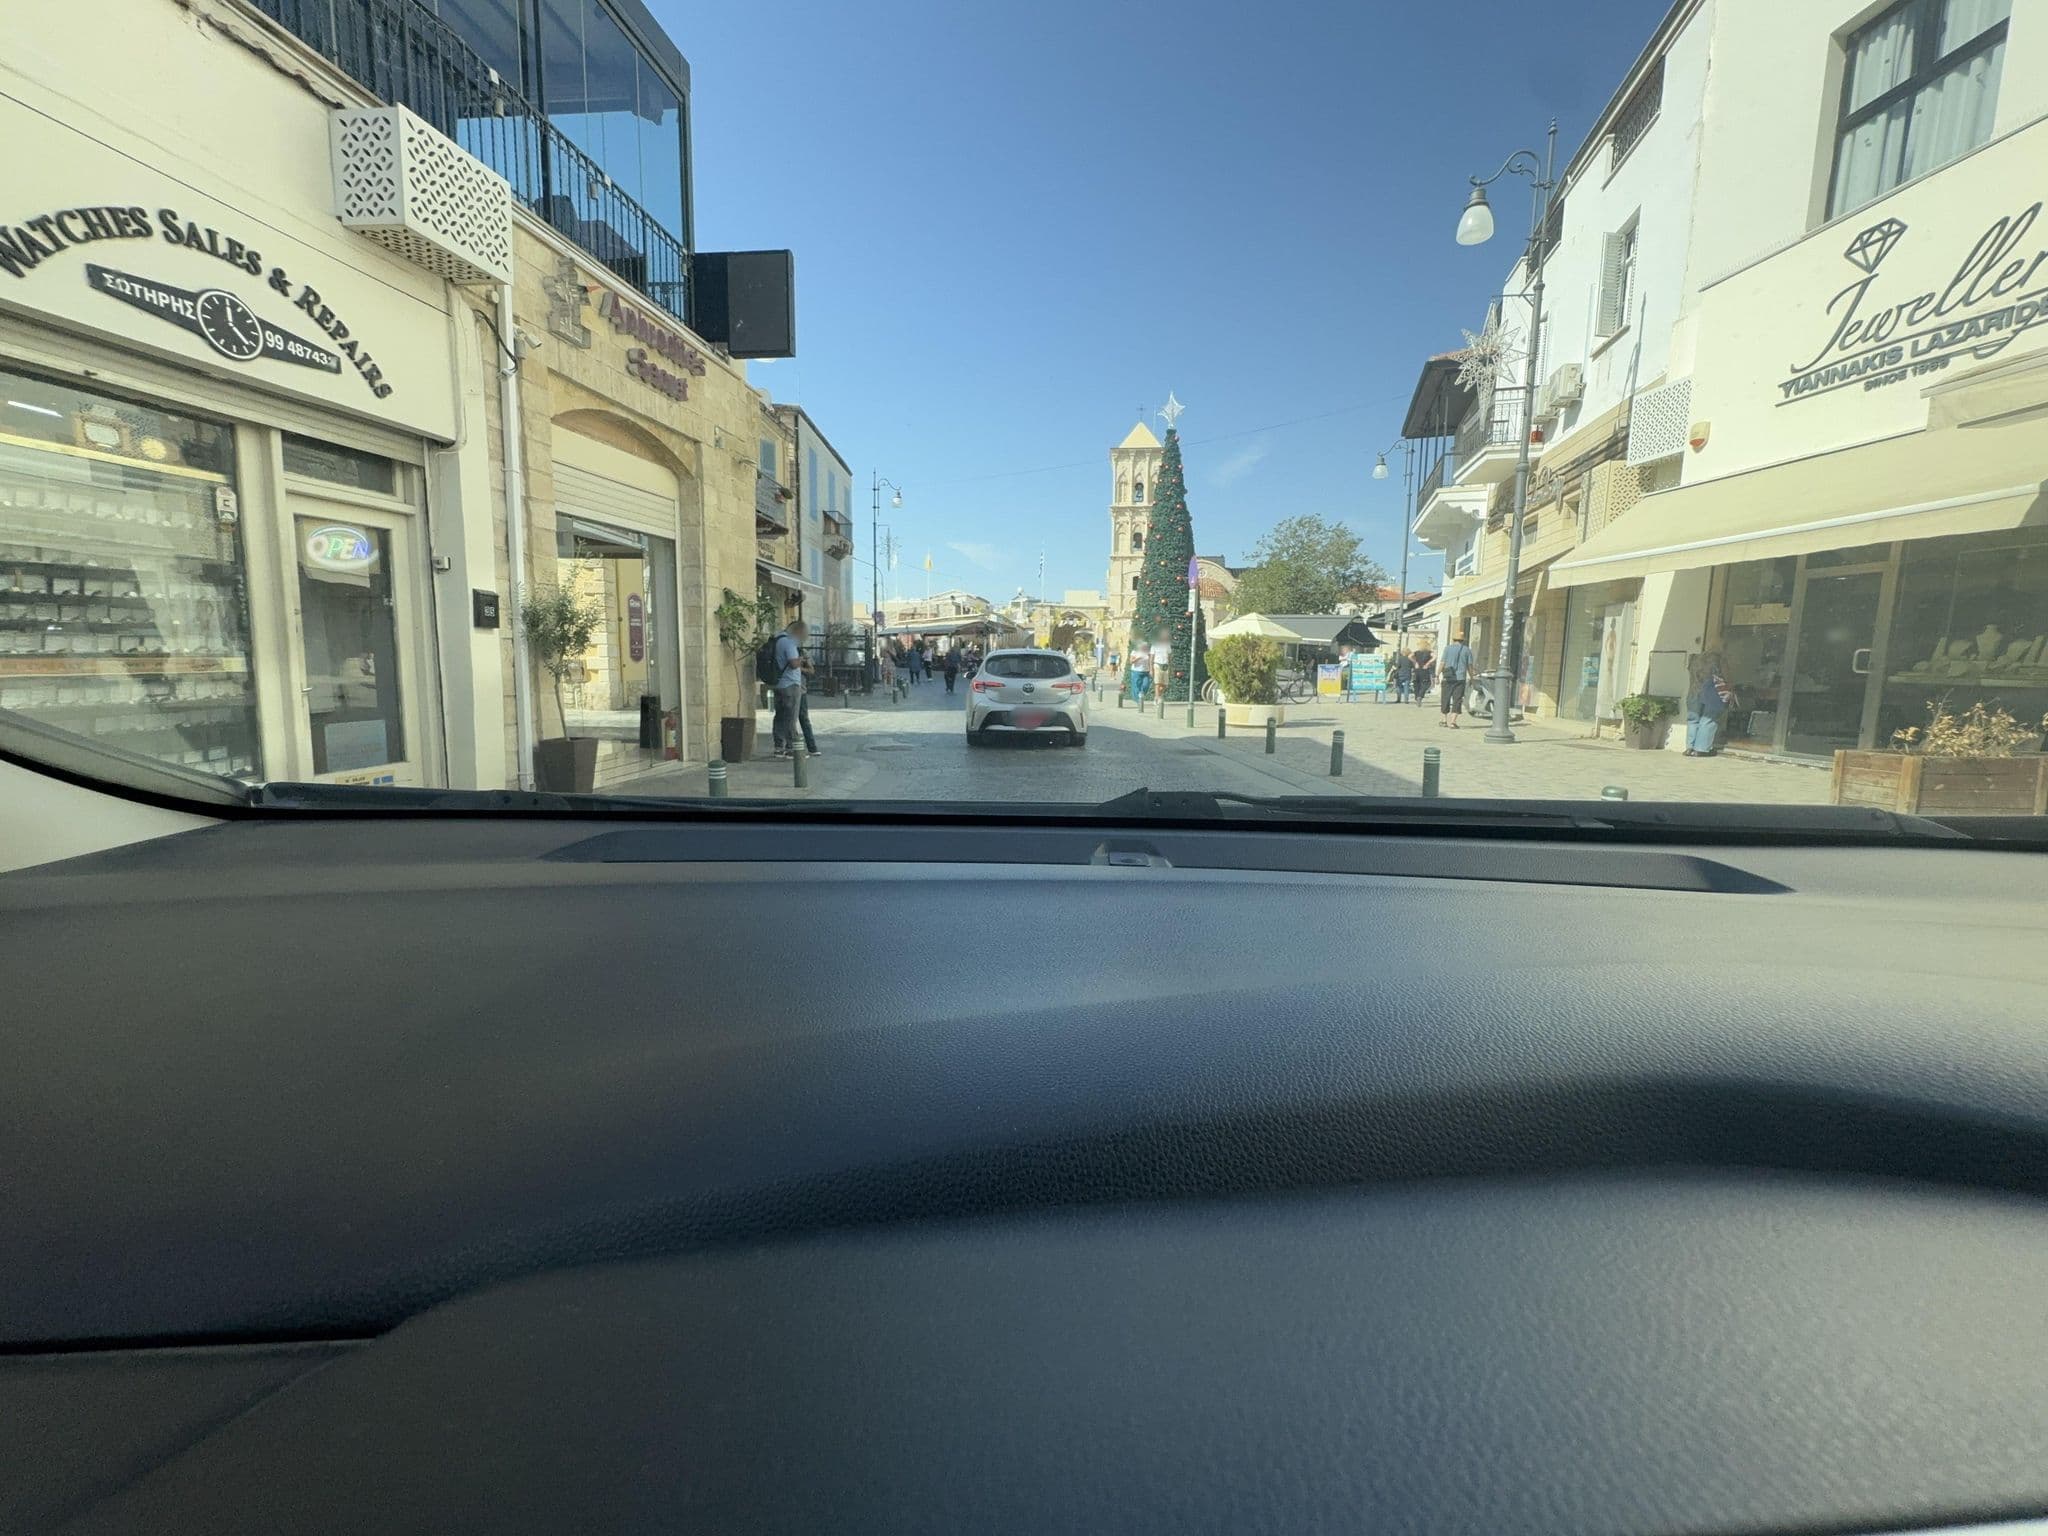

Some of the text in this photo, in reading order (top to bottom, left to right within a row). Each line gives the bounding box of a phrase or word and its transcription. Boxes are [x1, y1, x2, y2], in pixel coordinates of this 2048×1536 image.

[0, 207, 393, 399] WATCHES SALES & REPAIRS
[102, 272, 197, 320] ΣΩΤΗΡΗΣ
[1791, 202, 2048, 373] Jeweller
[265, 330, 337, 368] 99 48743
[1781, 346, 1904, 399] YIANNAKIS
[306, 535, 369, 561] OPEN
